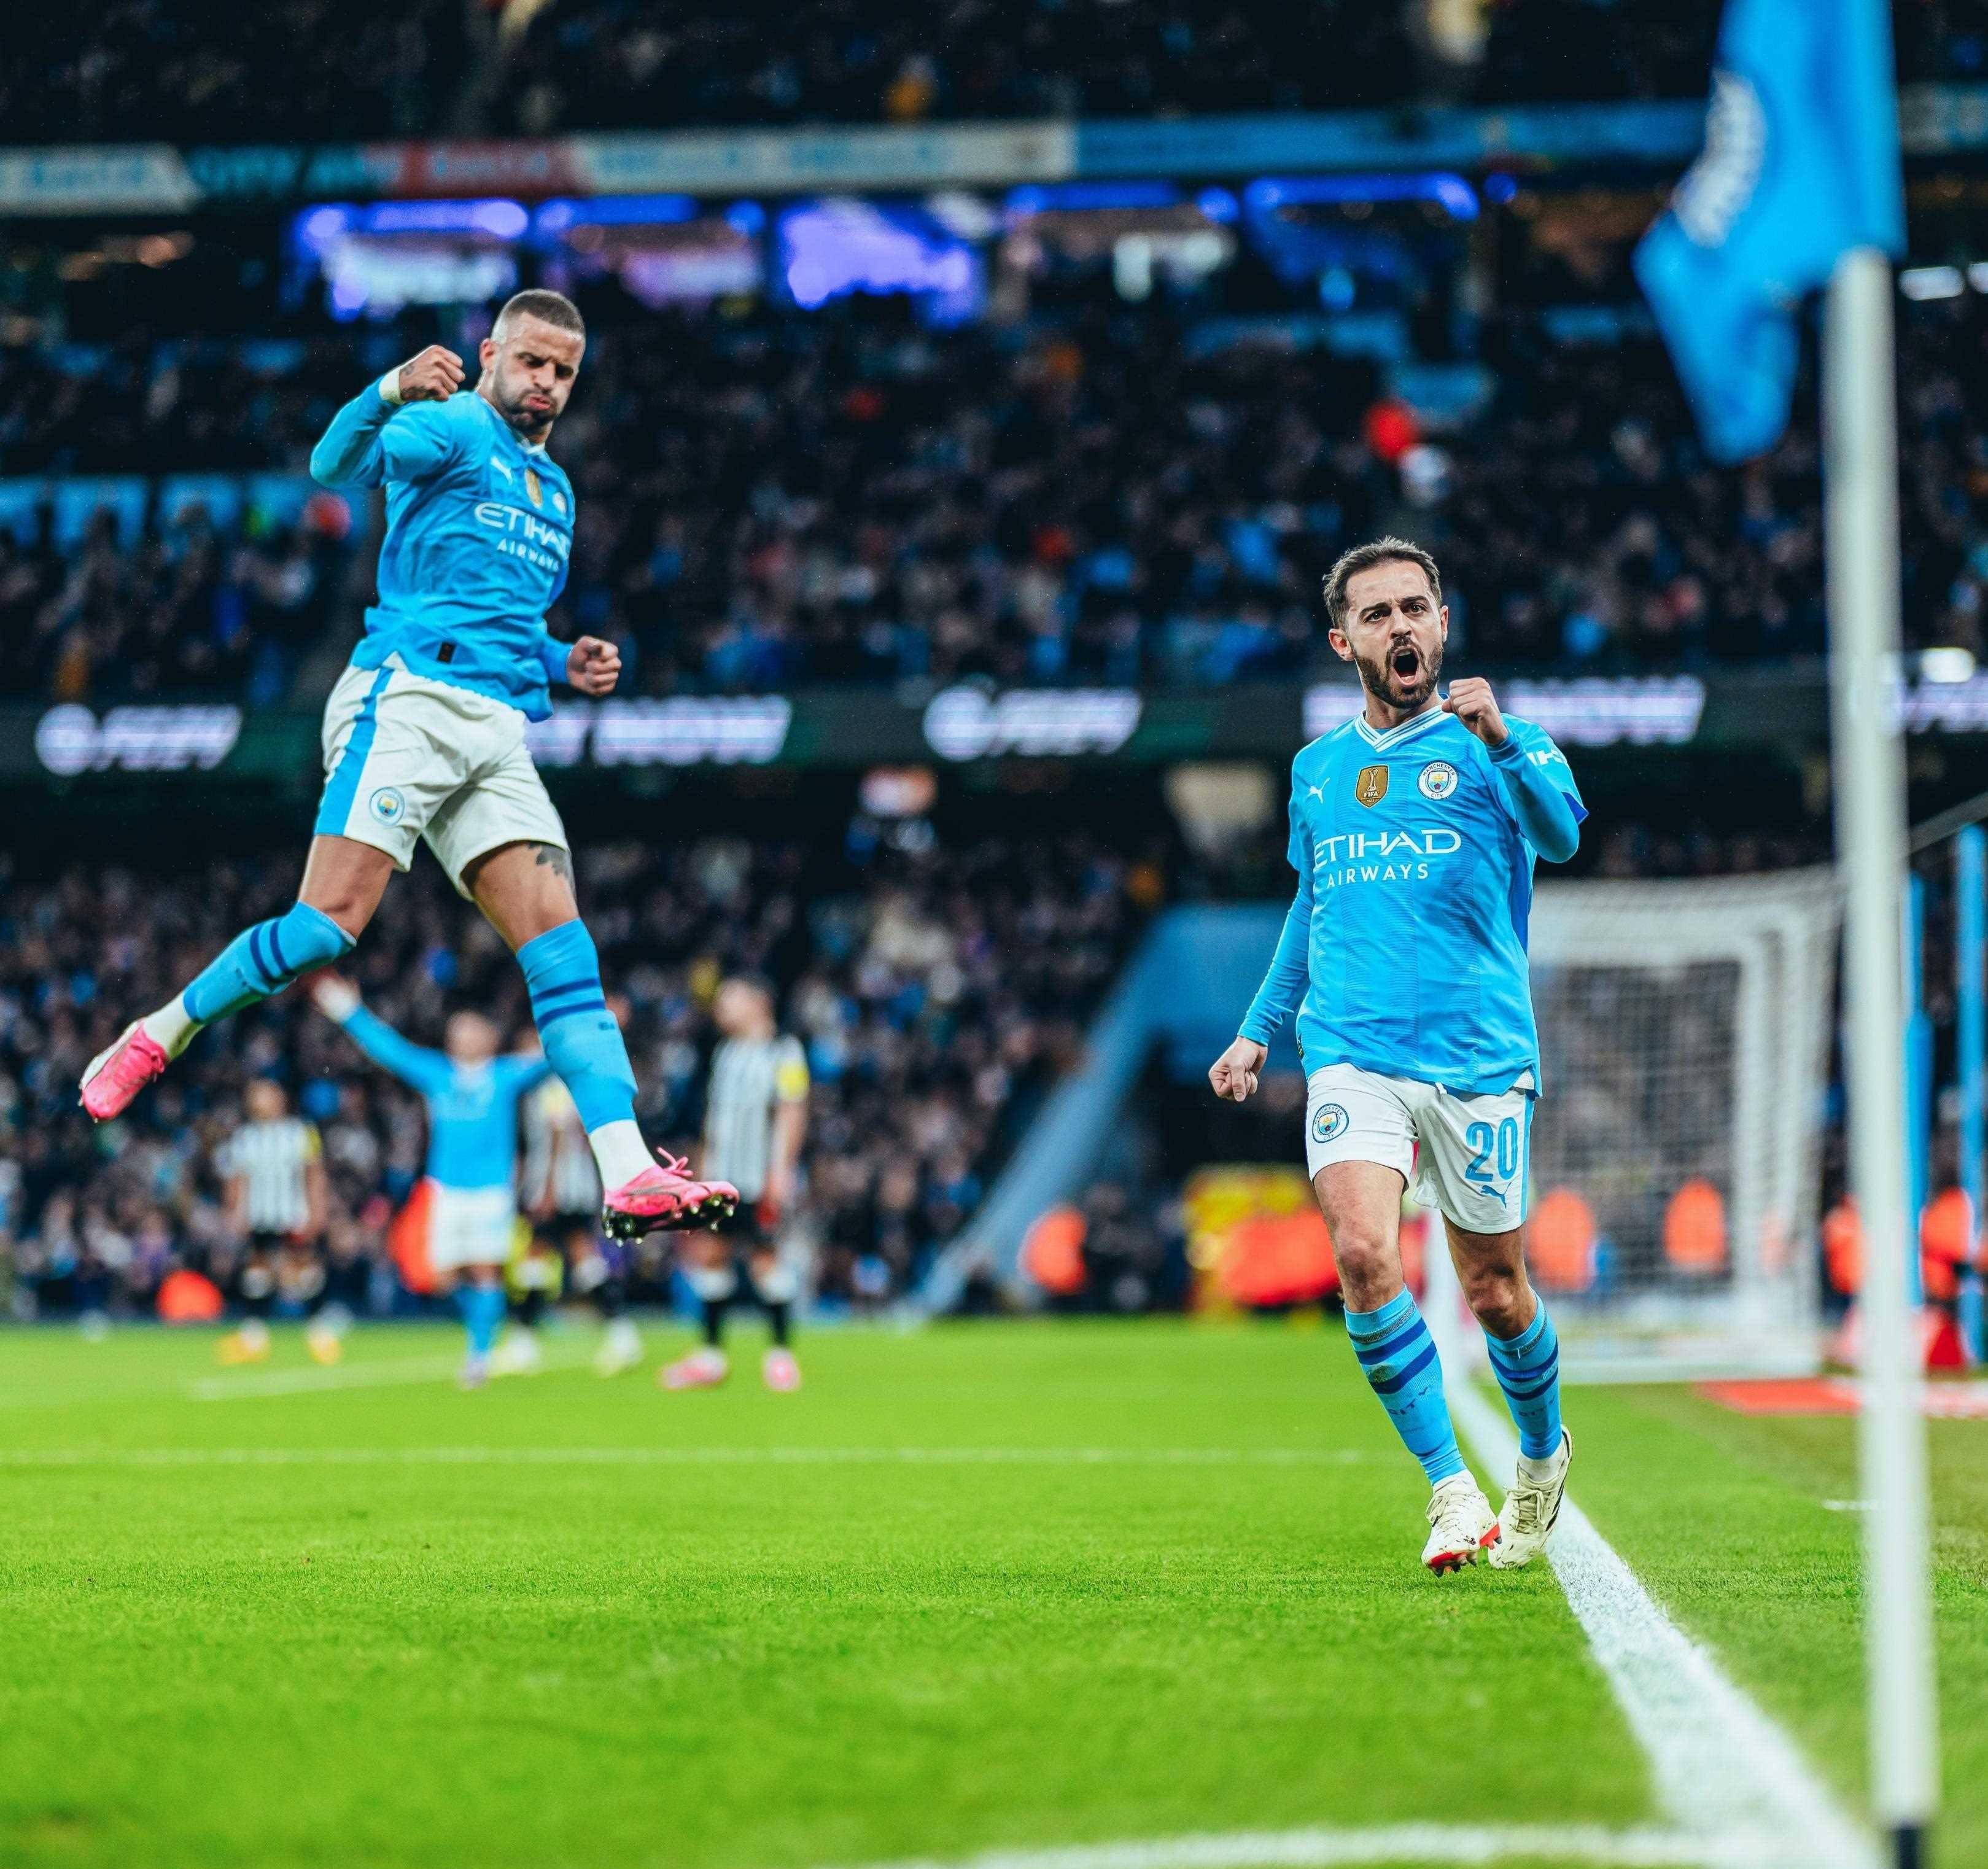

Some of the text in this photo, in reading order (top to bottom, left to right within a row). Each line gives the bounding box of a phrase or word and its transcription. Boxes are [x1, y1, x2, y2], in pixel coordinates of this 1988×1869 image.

[496, 538, 560, 572] AIRWAYS
[1423, 763, 1456, 777] MANCHESTER
[1313, 828, 1462, 871] ETIHAD
[1326, 863, 1430, 890] AIRWAYS
[1464, 1116, 1518, 1182] 20
